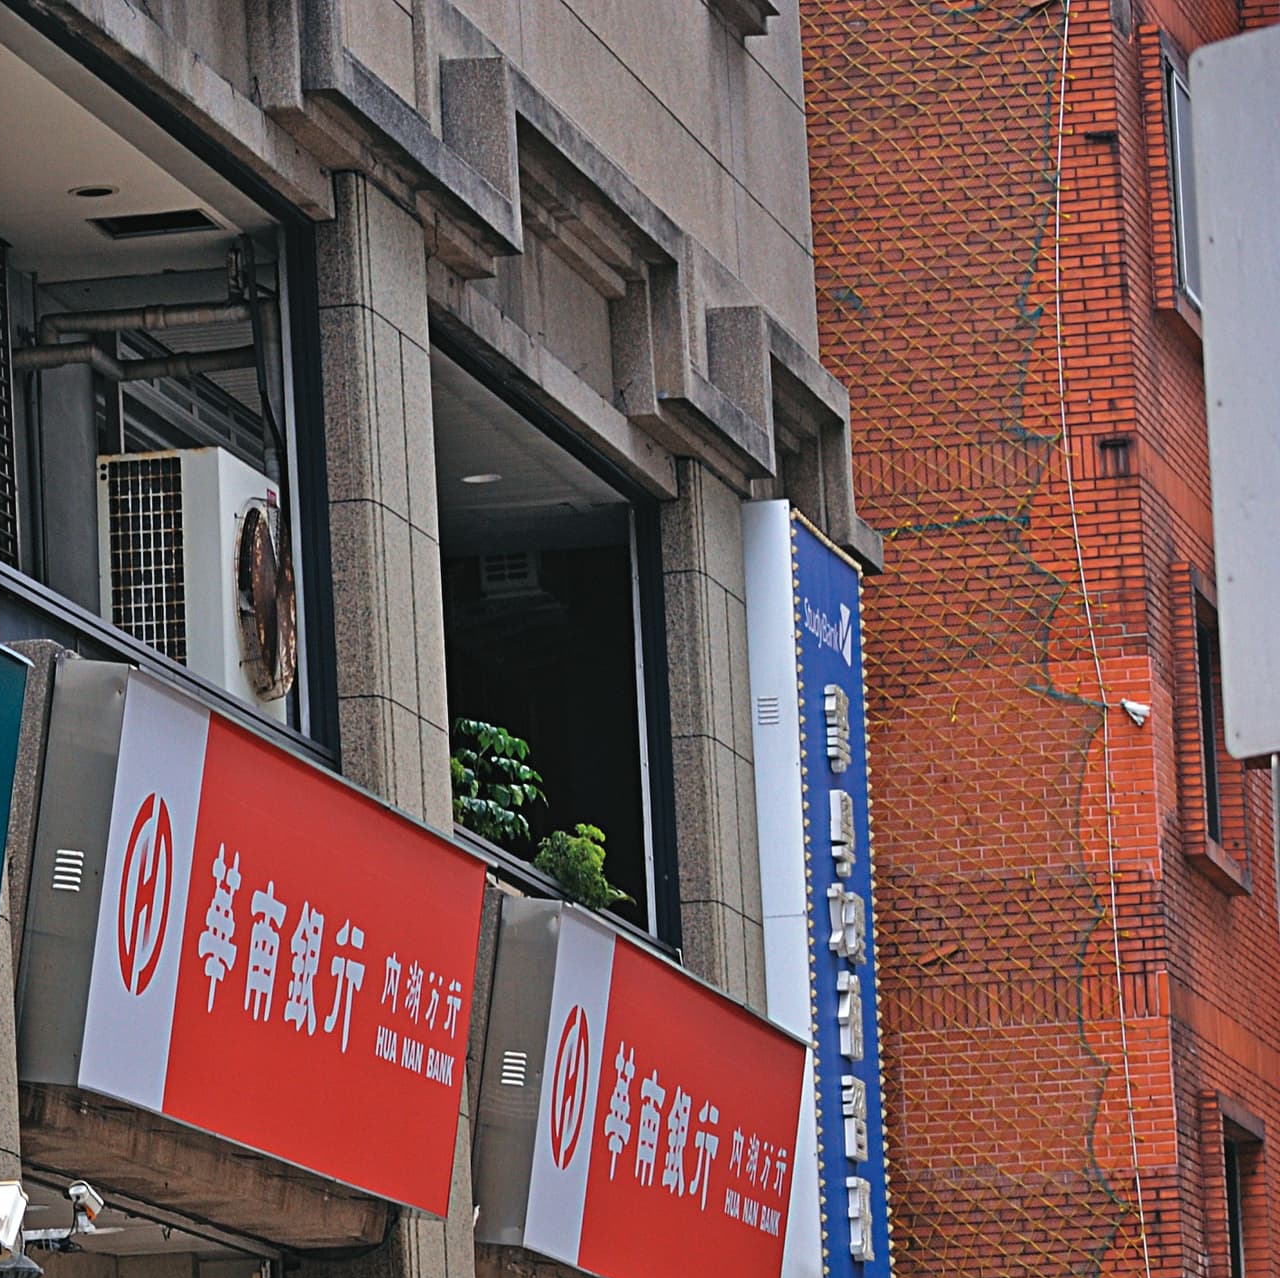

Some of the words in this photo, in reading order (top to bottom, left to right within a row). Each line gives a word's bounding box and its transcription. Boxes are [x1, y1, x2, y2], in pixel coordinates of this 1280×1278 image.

[803, 597, 840, 655] StudyBank
[197, 841, 368, 1054] 華南銀行
[381, 951, 462, 1039] 內湖分行
[375, 1025, 397, 1064] HUA
[401, 1036, 424, 1074] NAN
[426, 1047, 455, 1087] BANK
[603, 1040, 720, 1212] 華南銀行
[724, 1187, 740, 1220] HUA
[742, 1196, 759, 1228] NAN
[760, 1205, 781, 1238] BANK
